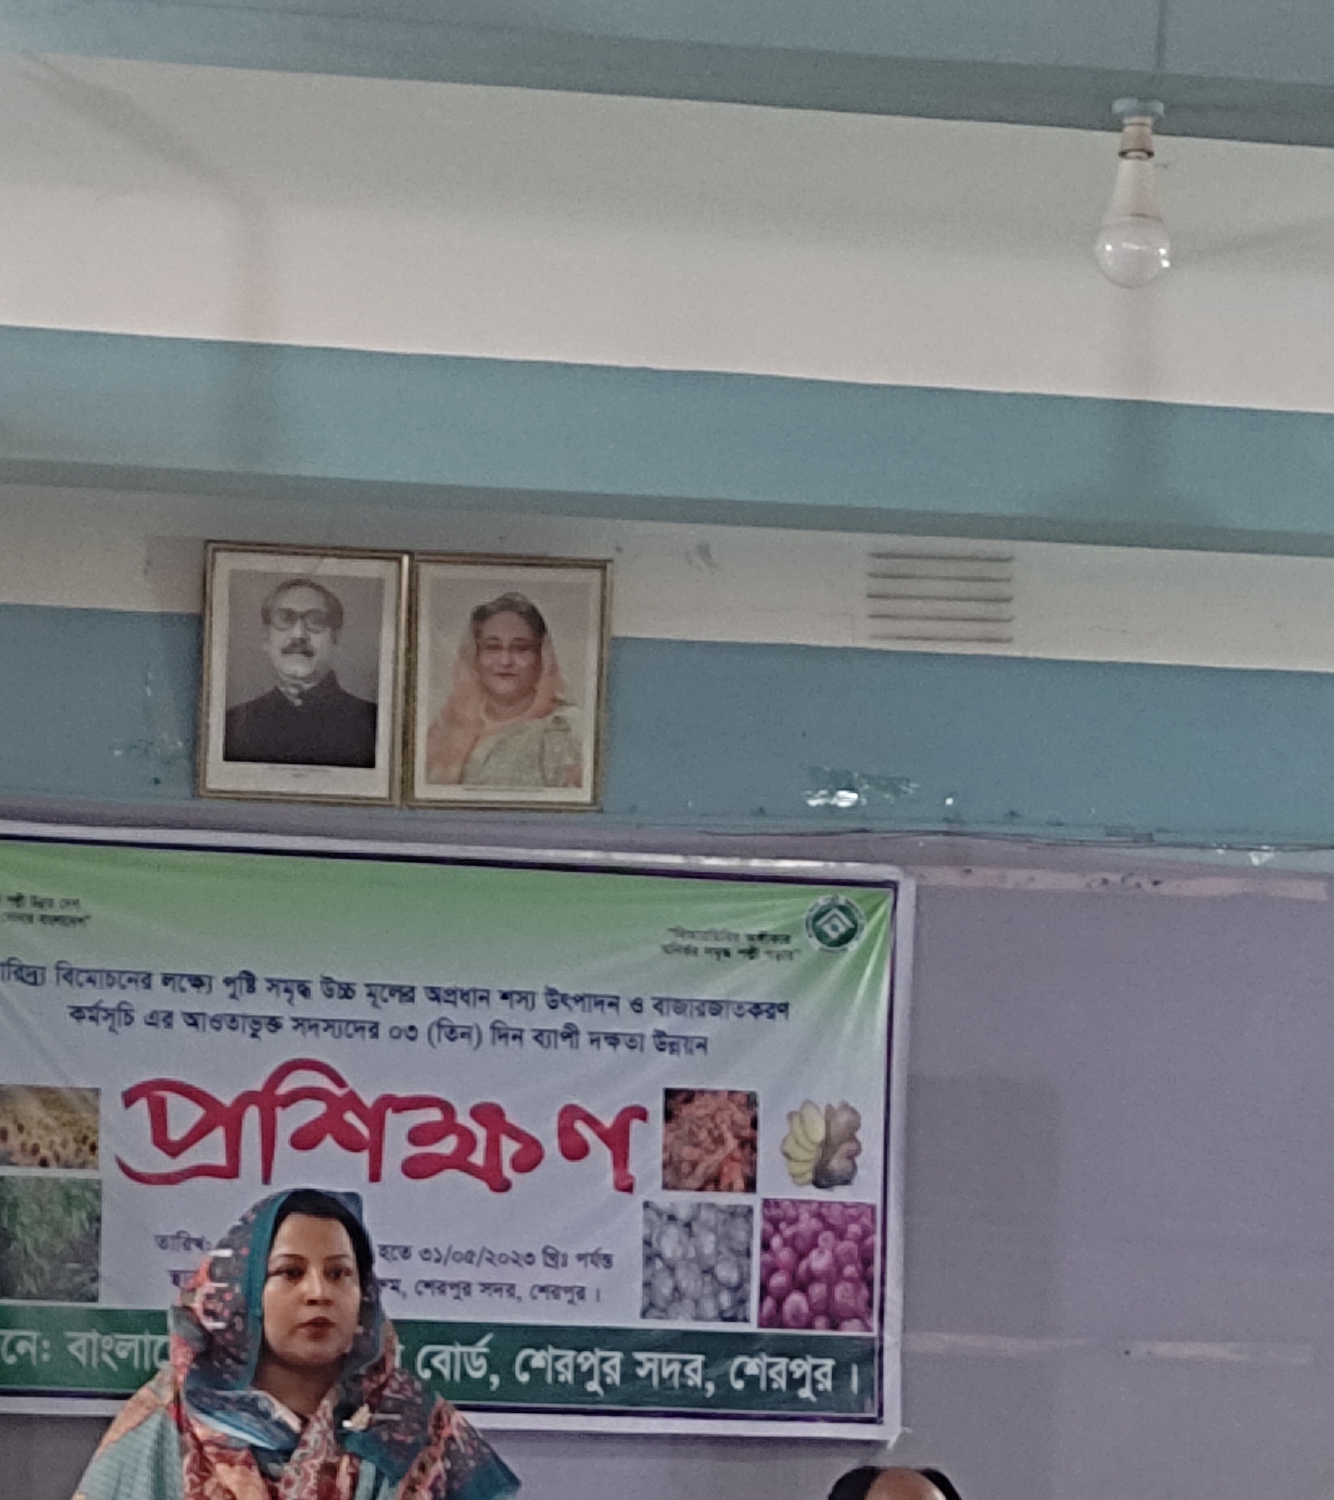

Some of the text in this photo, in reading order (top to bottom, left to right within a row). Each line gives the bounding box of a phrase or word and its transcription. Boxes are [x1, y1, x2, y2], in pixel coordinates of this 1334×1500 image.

[55, 960, 152, 990] বিমোচনের
[222, 970, 258, 999] পুষ্টি
[265, 978, 312, 1007] সমৃদ্ধ
[320, 975, 357, 999] উচ্চ
[423, 985, 490, 1008] অপ্রধান
[497, 989, 536, 1011] শস্য
[545, 985, 620, 1017] উৎপাদন
[629, 997, 643, 1014] ও
[651, 996, 790, 1021] বাজারজাতকরণ
[67, 999, 135, 1034] কর্মসূচি
[144, 1009, 173, 1030] এর
[181, 1011, 284, 1041] আওতাভুক্ত
[291, 1015, 379, 1040] সদস্যদের
[389, 1024, 418, 1042] ০৩
[427, 1017, 482, 1051] (তিন)
[490, 1019, 524, 1049] দিন
[533, 1022, 580, 1051] ব্যাপী
[588, 1029, 645, 1053] দক্ষতা
[115, 1057, 649, 1194] প্রশিক্ষণ
[377, 1243, 412, 1264] হতে
[418, 1244, 536, 1268] ৩১/০৫/২০২৩
[415, 1279, 474, 1302] শেরপুর
[529, 1283, 587, 1306] শেরপুর
[415, 1332, 500, 1391] বোর্ড,
[514, 1343, 622, 1397] শেরপুর
[635, 1348, 717, 1398] সদর,
[728, 1351, 836, 1401] শেরপুর
